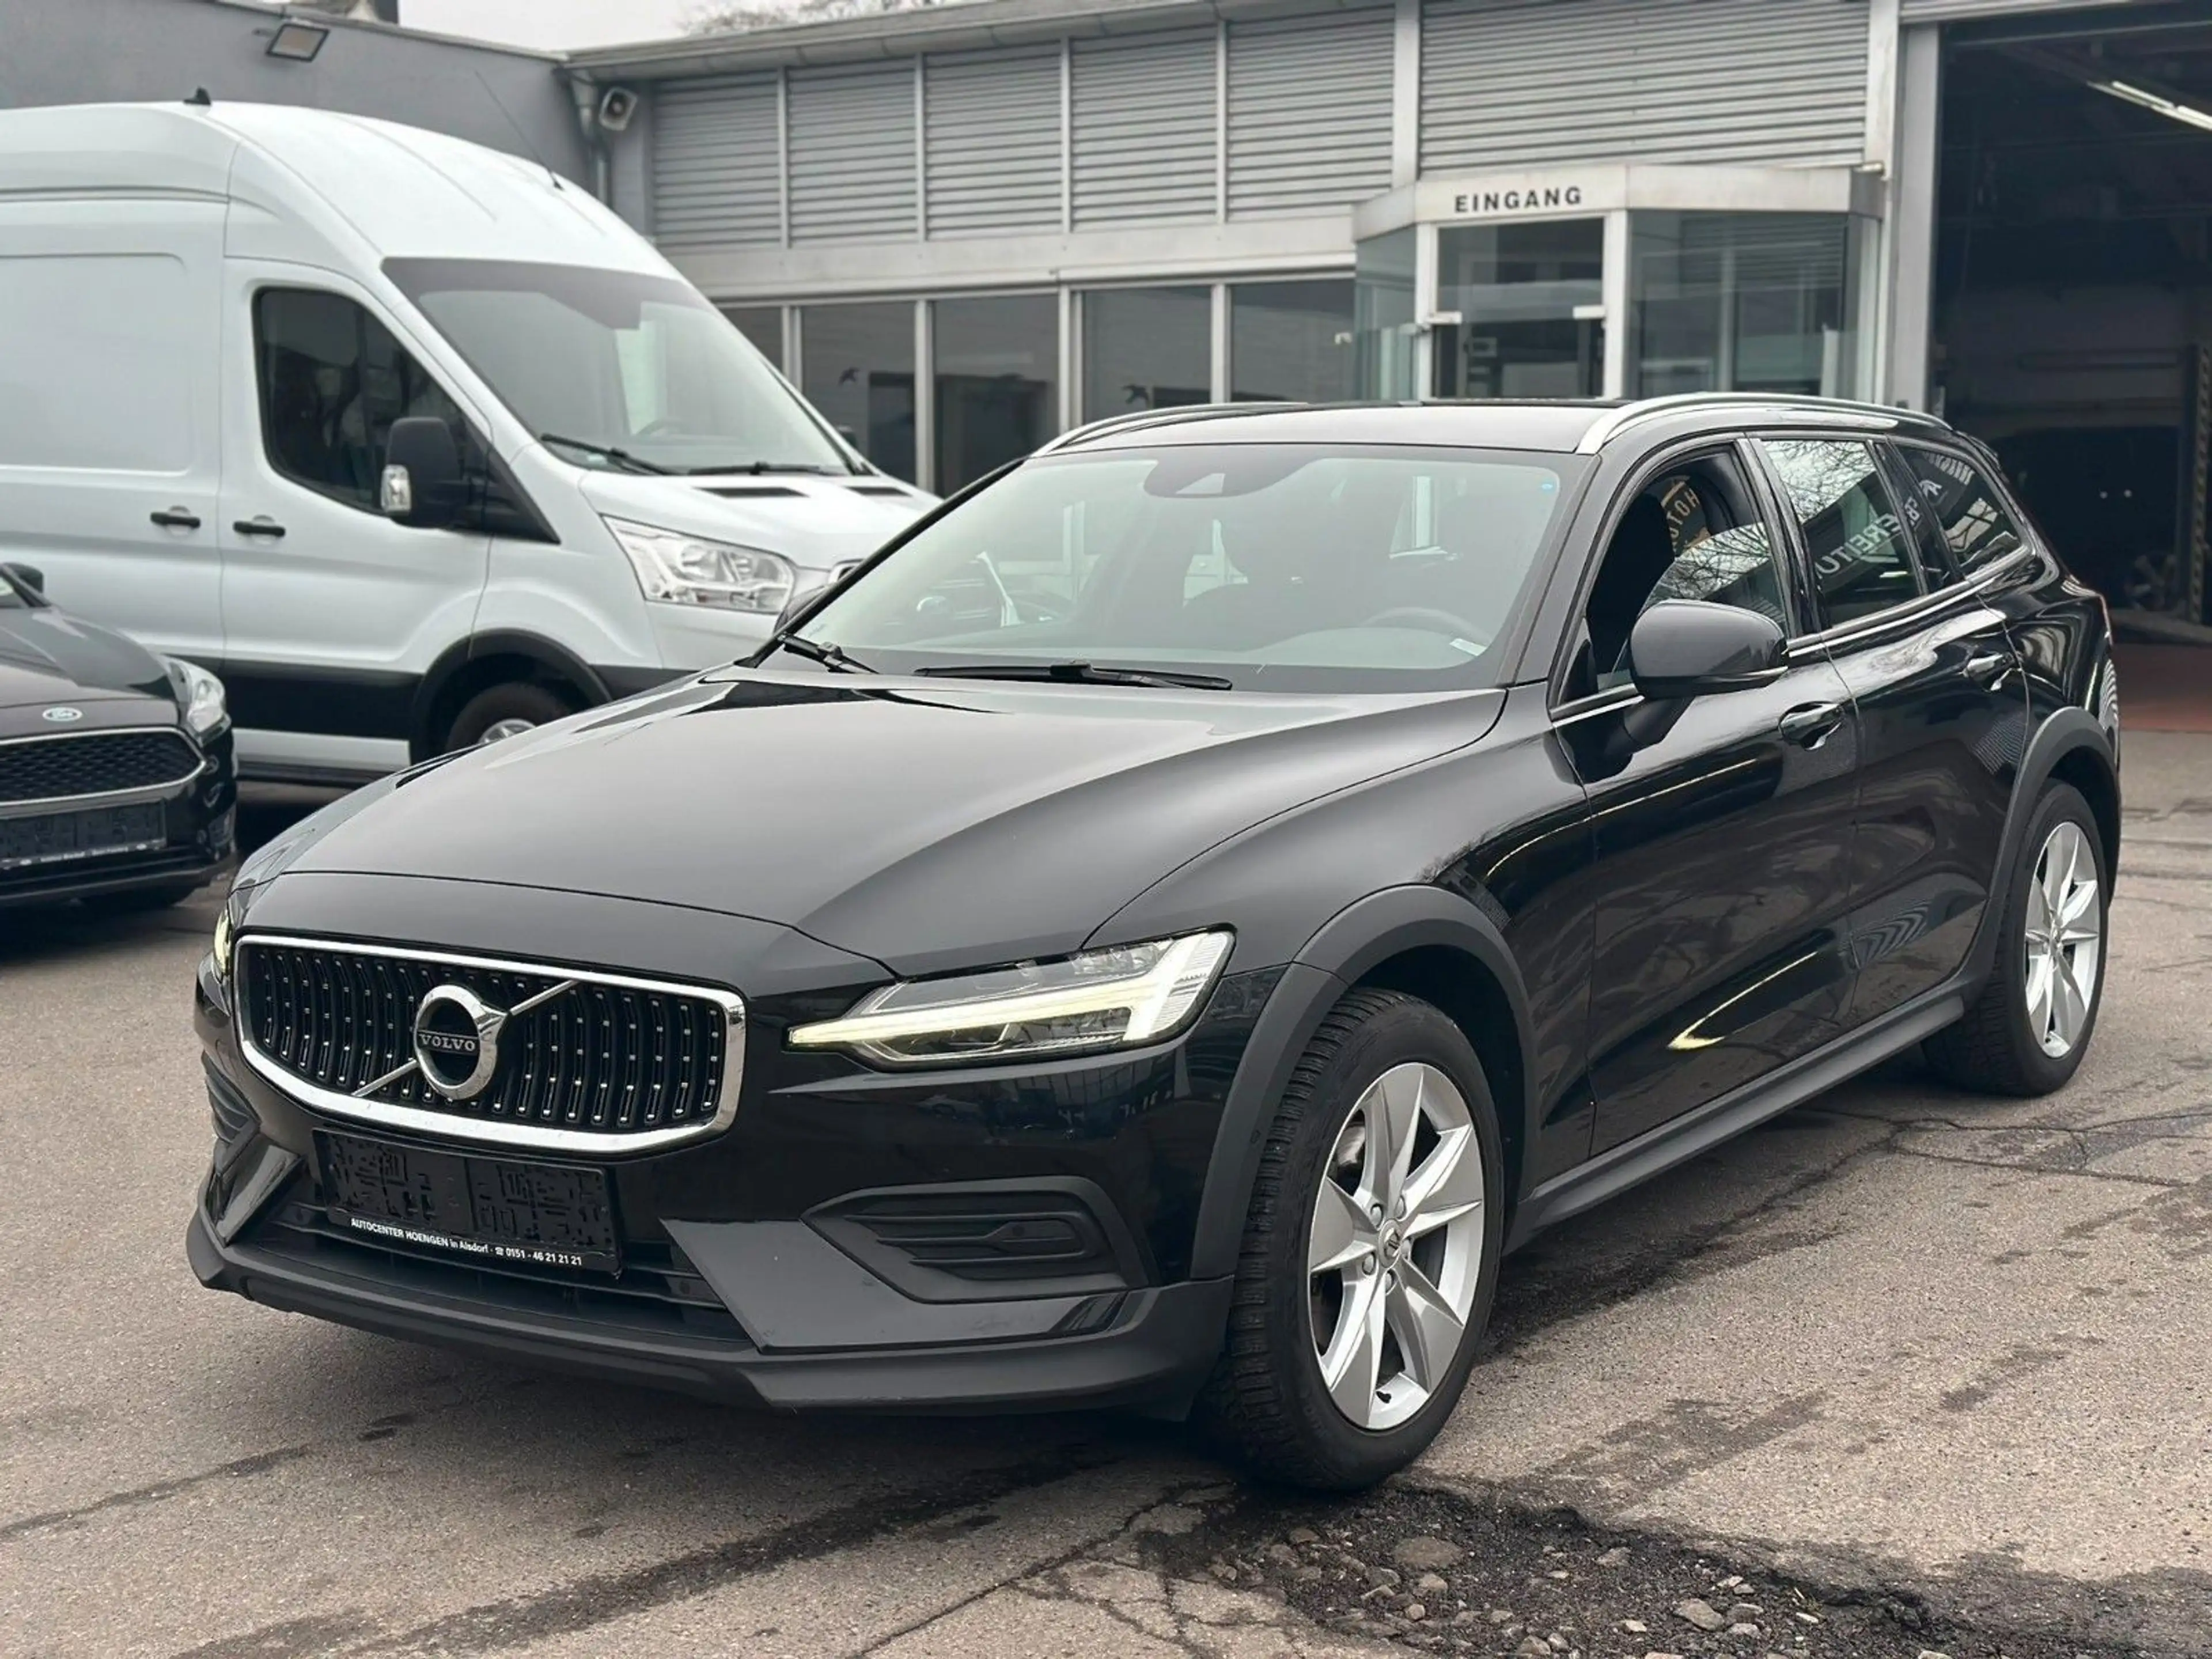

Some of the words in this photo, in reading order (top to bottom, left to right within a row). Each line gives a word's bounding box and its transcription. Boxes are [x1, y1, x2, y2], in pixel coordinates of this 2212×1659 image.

[1455, 186, 1582, 213] EINGANG
[419, 1034, 475, 1051] VOLVO
[351, 1218, 404, 1238] AUTOCENTER
[405, 1230, 448, 1247] HOENGEN
[450, 1238, 458, 1249] in
[506, 1247, 525, 1259] 0151
[546, 1252, 556, 1263] 21
[558, 1253, 569, 1264] 21
[571, 1256, 582, 1266] 21
